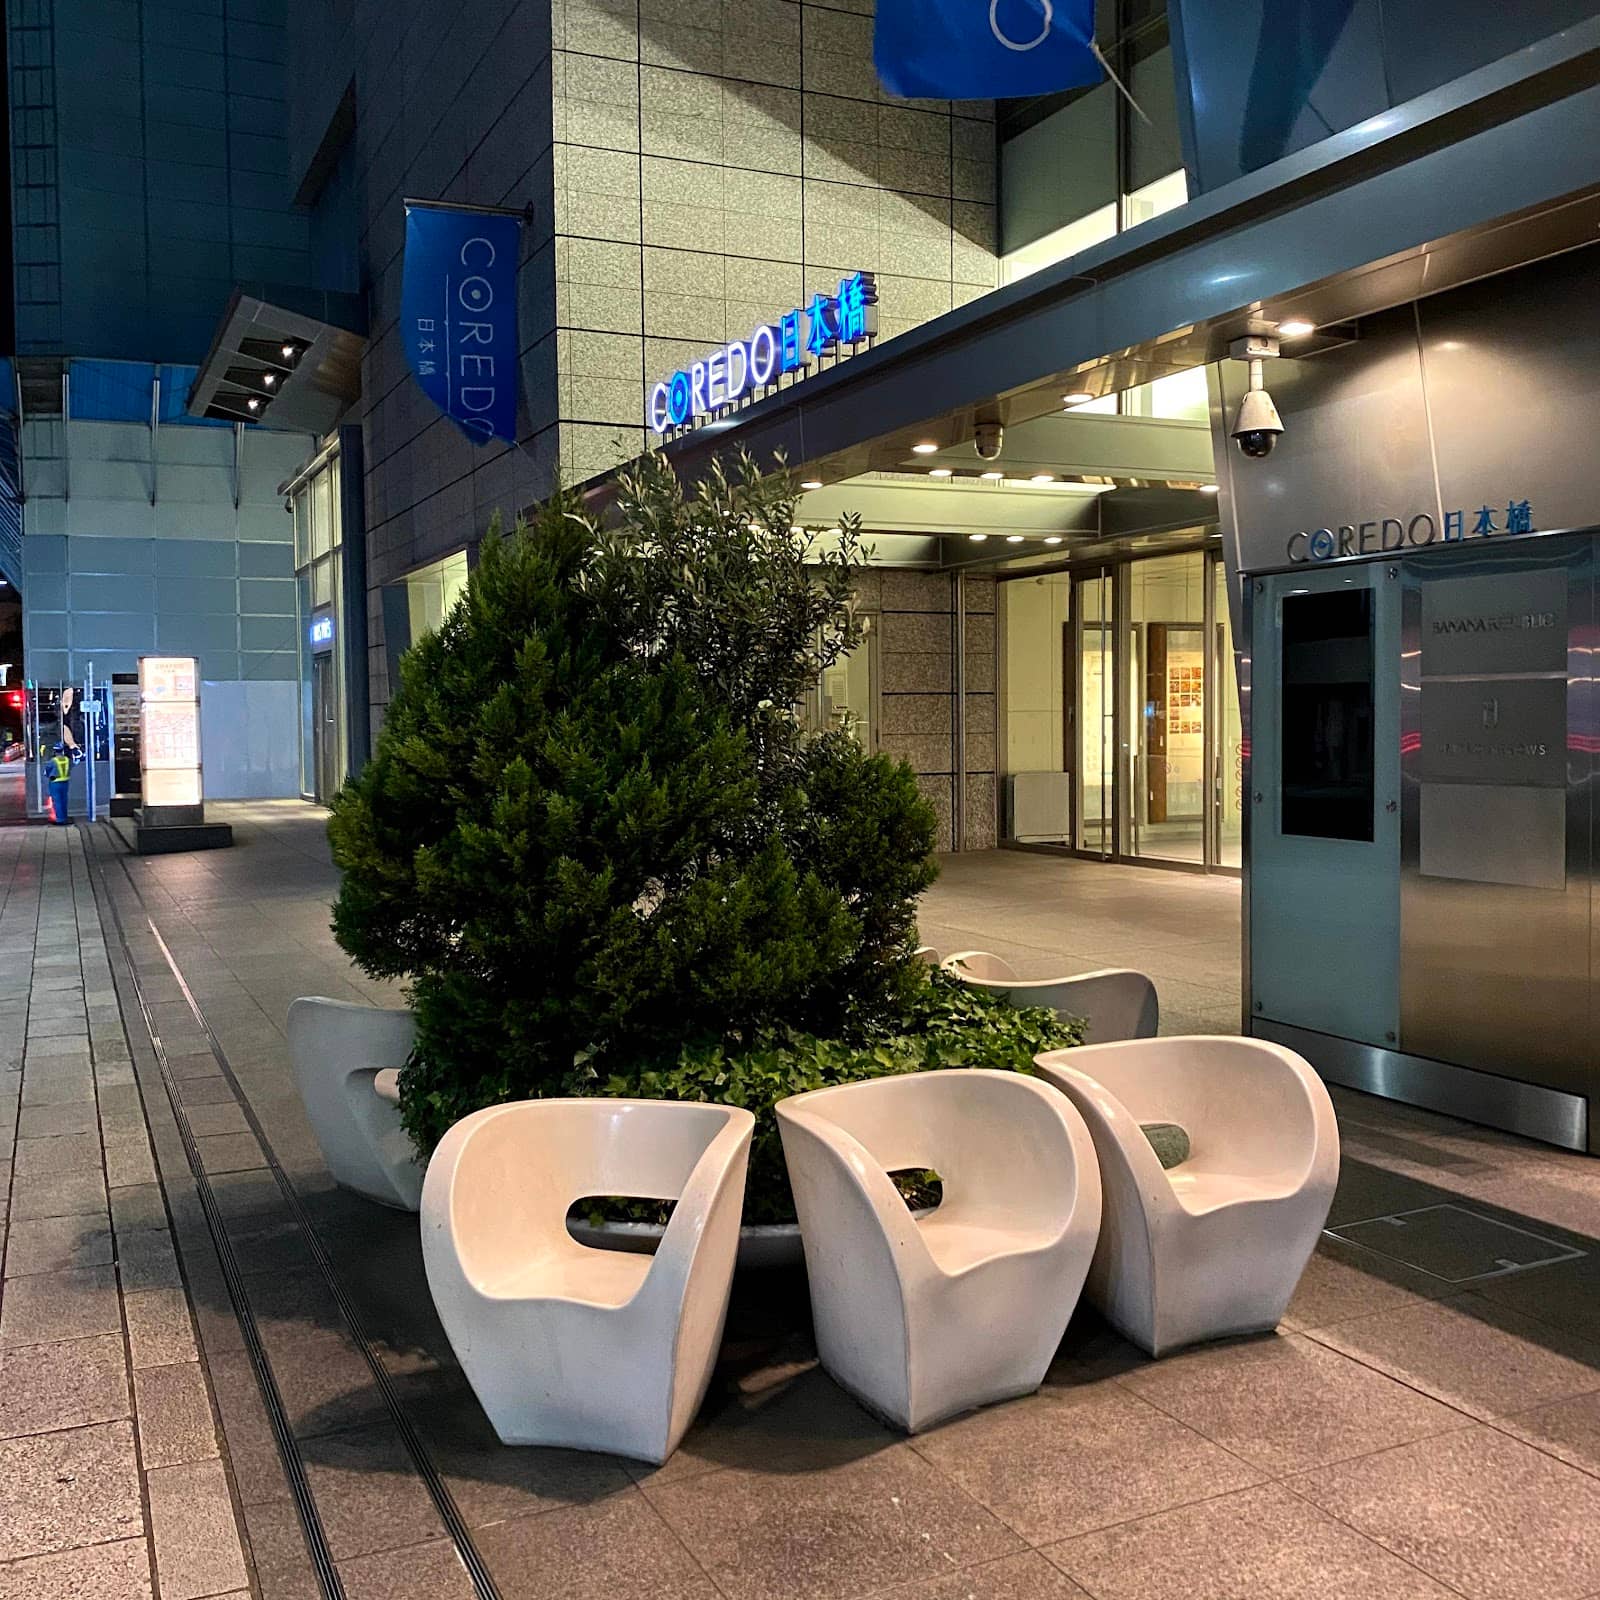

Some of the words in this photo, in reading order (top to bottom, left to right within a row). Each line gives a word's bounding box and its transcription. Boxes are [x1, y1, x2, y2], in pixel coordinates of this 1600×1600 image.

[651, 324, 774, 432] COREDO
[780, 271, 874, 374] 日本橋
[1287, 513, 1435, 561] COREDO
[1443, 499, 1534, 544] 日本橋
